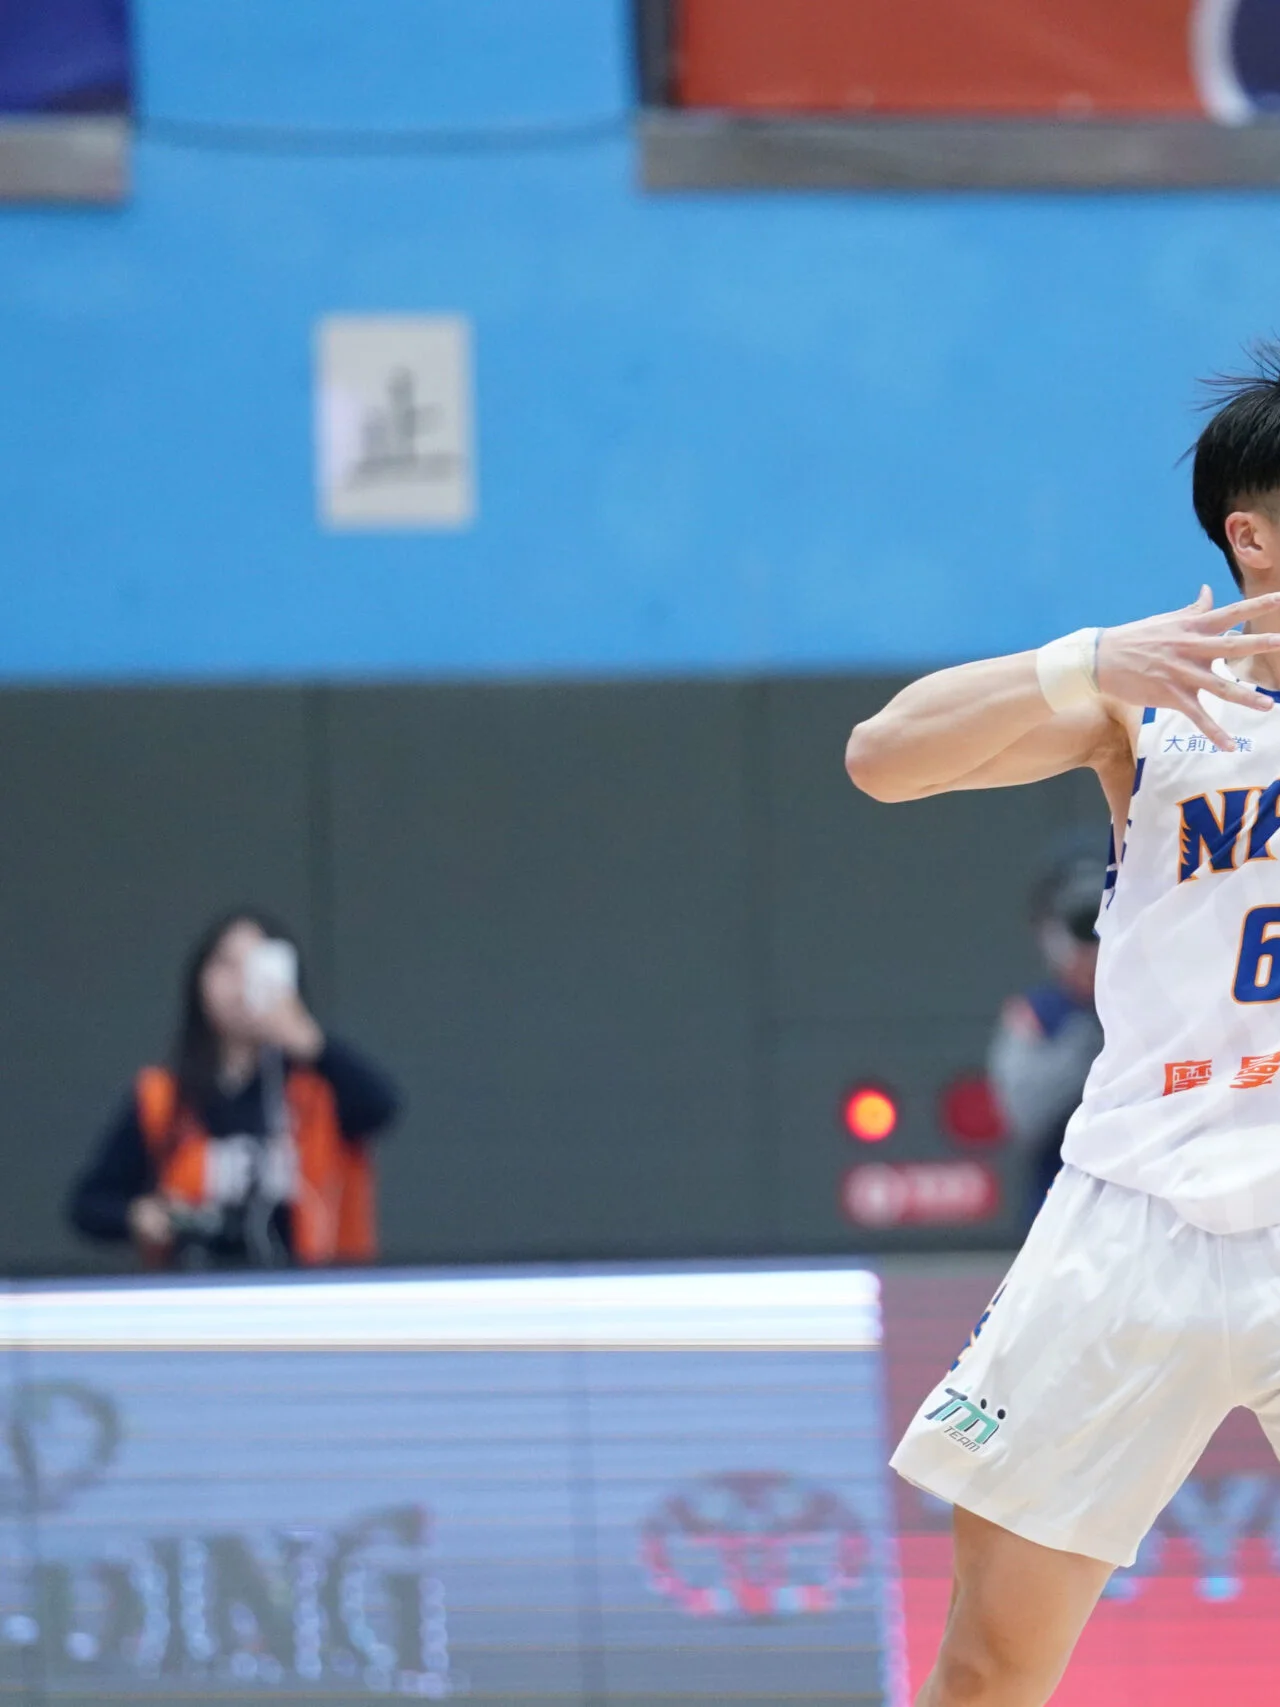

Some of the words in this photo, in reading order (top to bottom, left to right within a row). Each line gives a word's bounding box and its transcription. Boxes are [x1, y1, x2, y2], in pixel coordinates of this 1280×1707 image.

[1163, 734, 1253, 753] 大前業
[943, 1425, 981, 1453] TEAM
